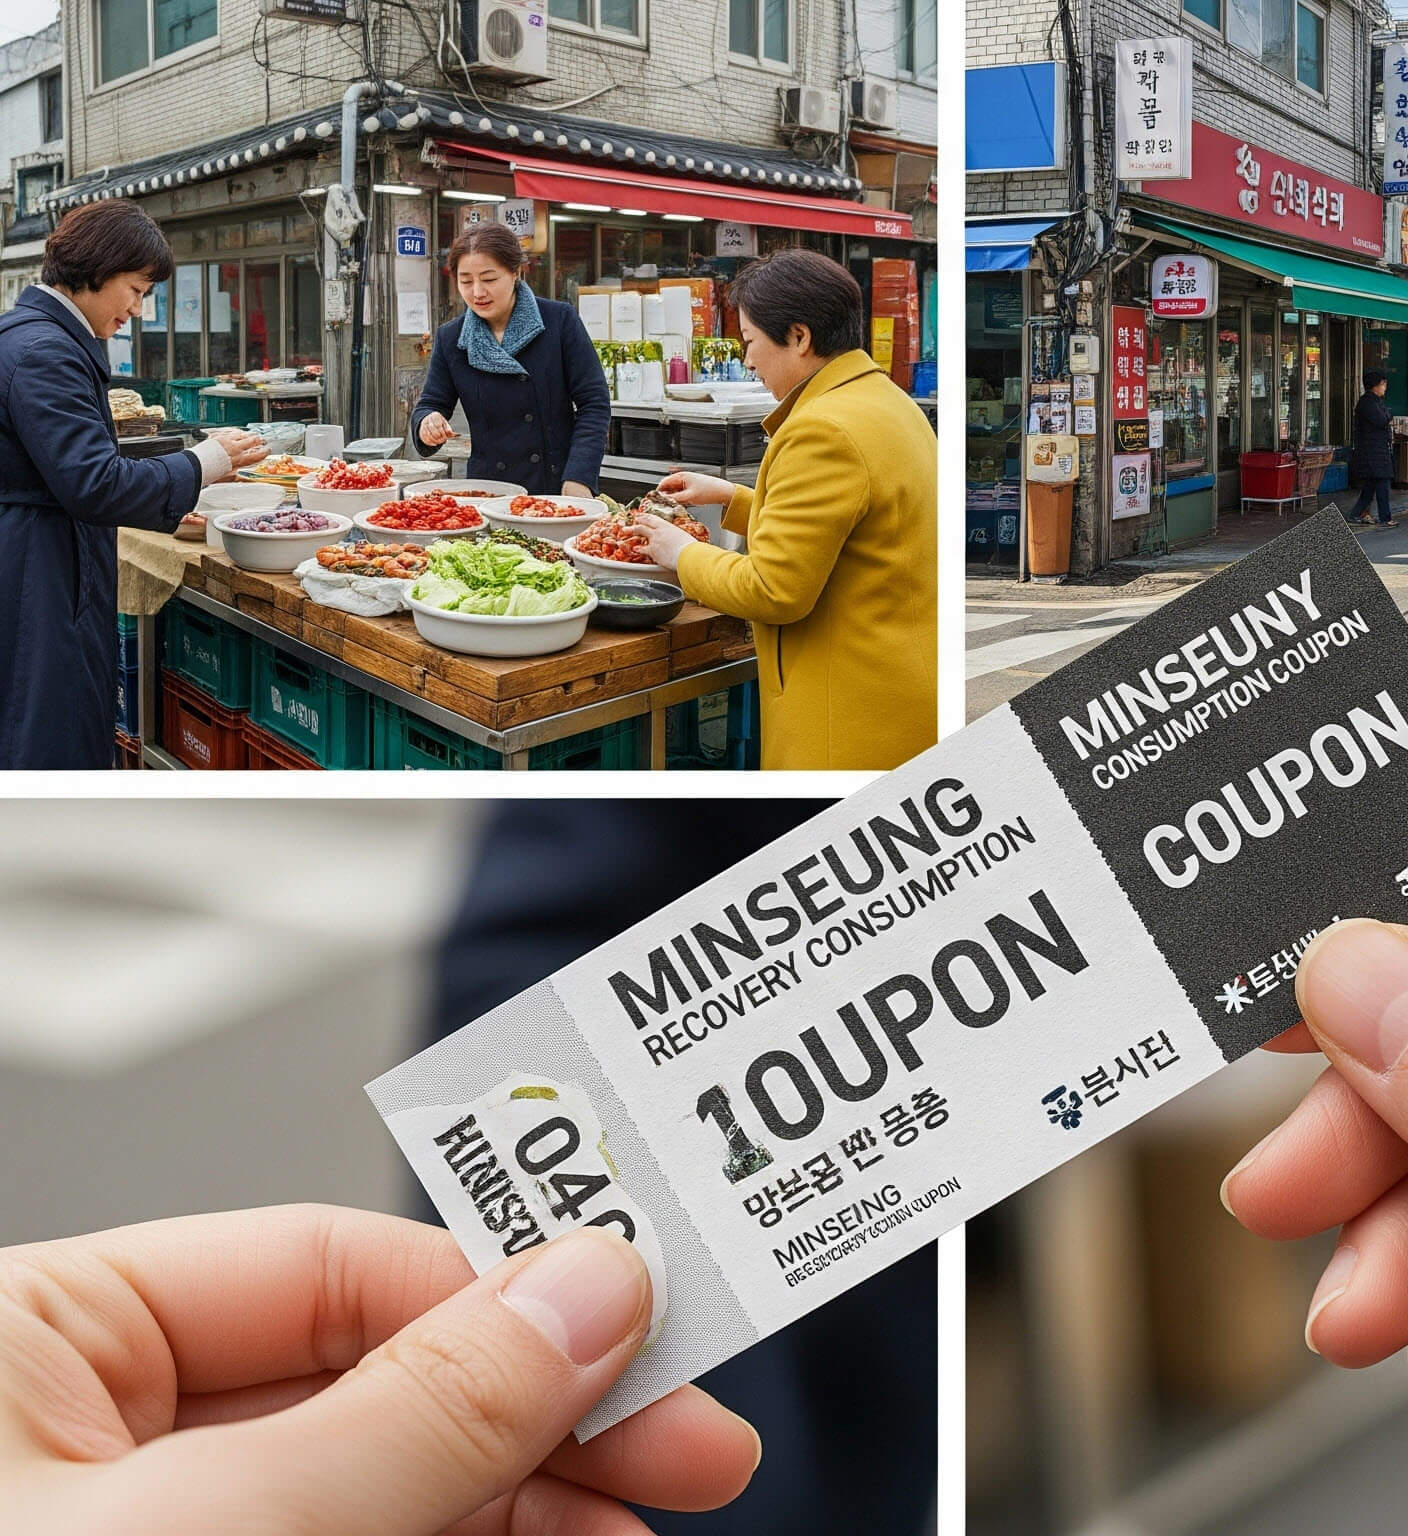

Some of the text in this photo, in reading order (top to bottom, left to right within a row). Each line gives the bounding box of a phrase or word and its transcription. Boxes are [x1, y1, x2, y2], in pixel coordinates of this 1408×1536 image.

[1058, 568, 1322, 761] MINSEUNY
[1092, 609, 1370, 790] CONSUMPTION COUPON
[607, 777, 983, 1031] MINSEUNG
[641, 815, 1036, 1067] RECOVERY CONSUMPTION
